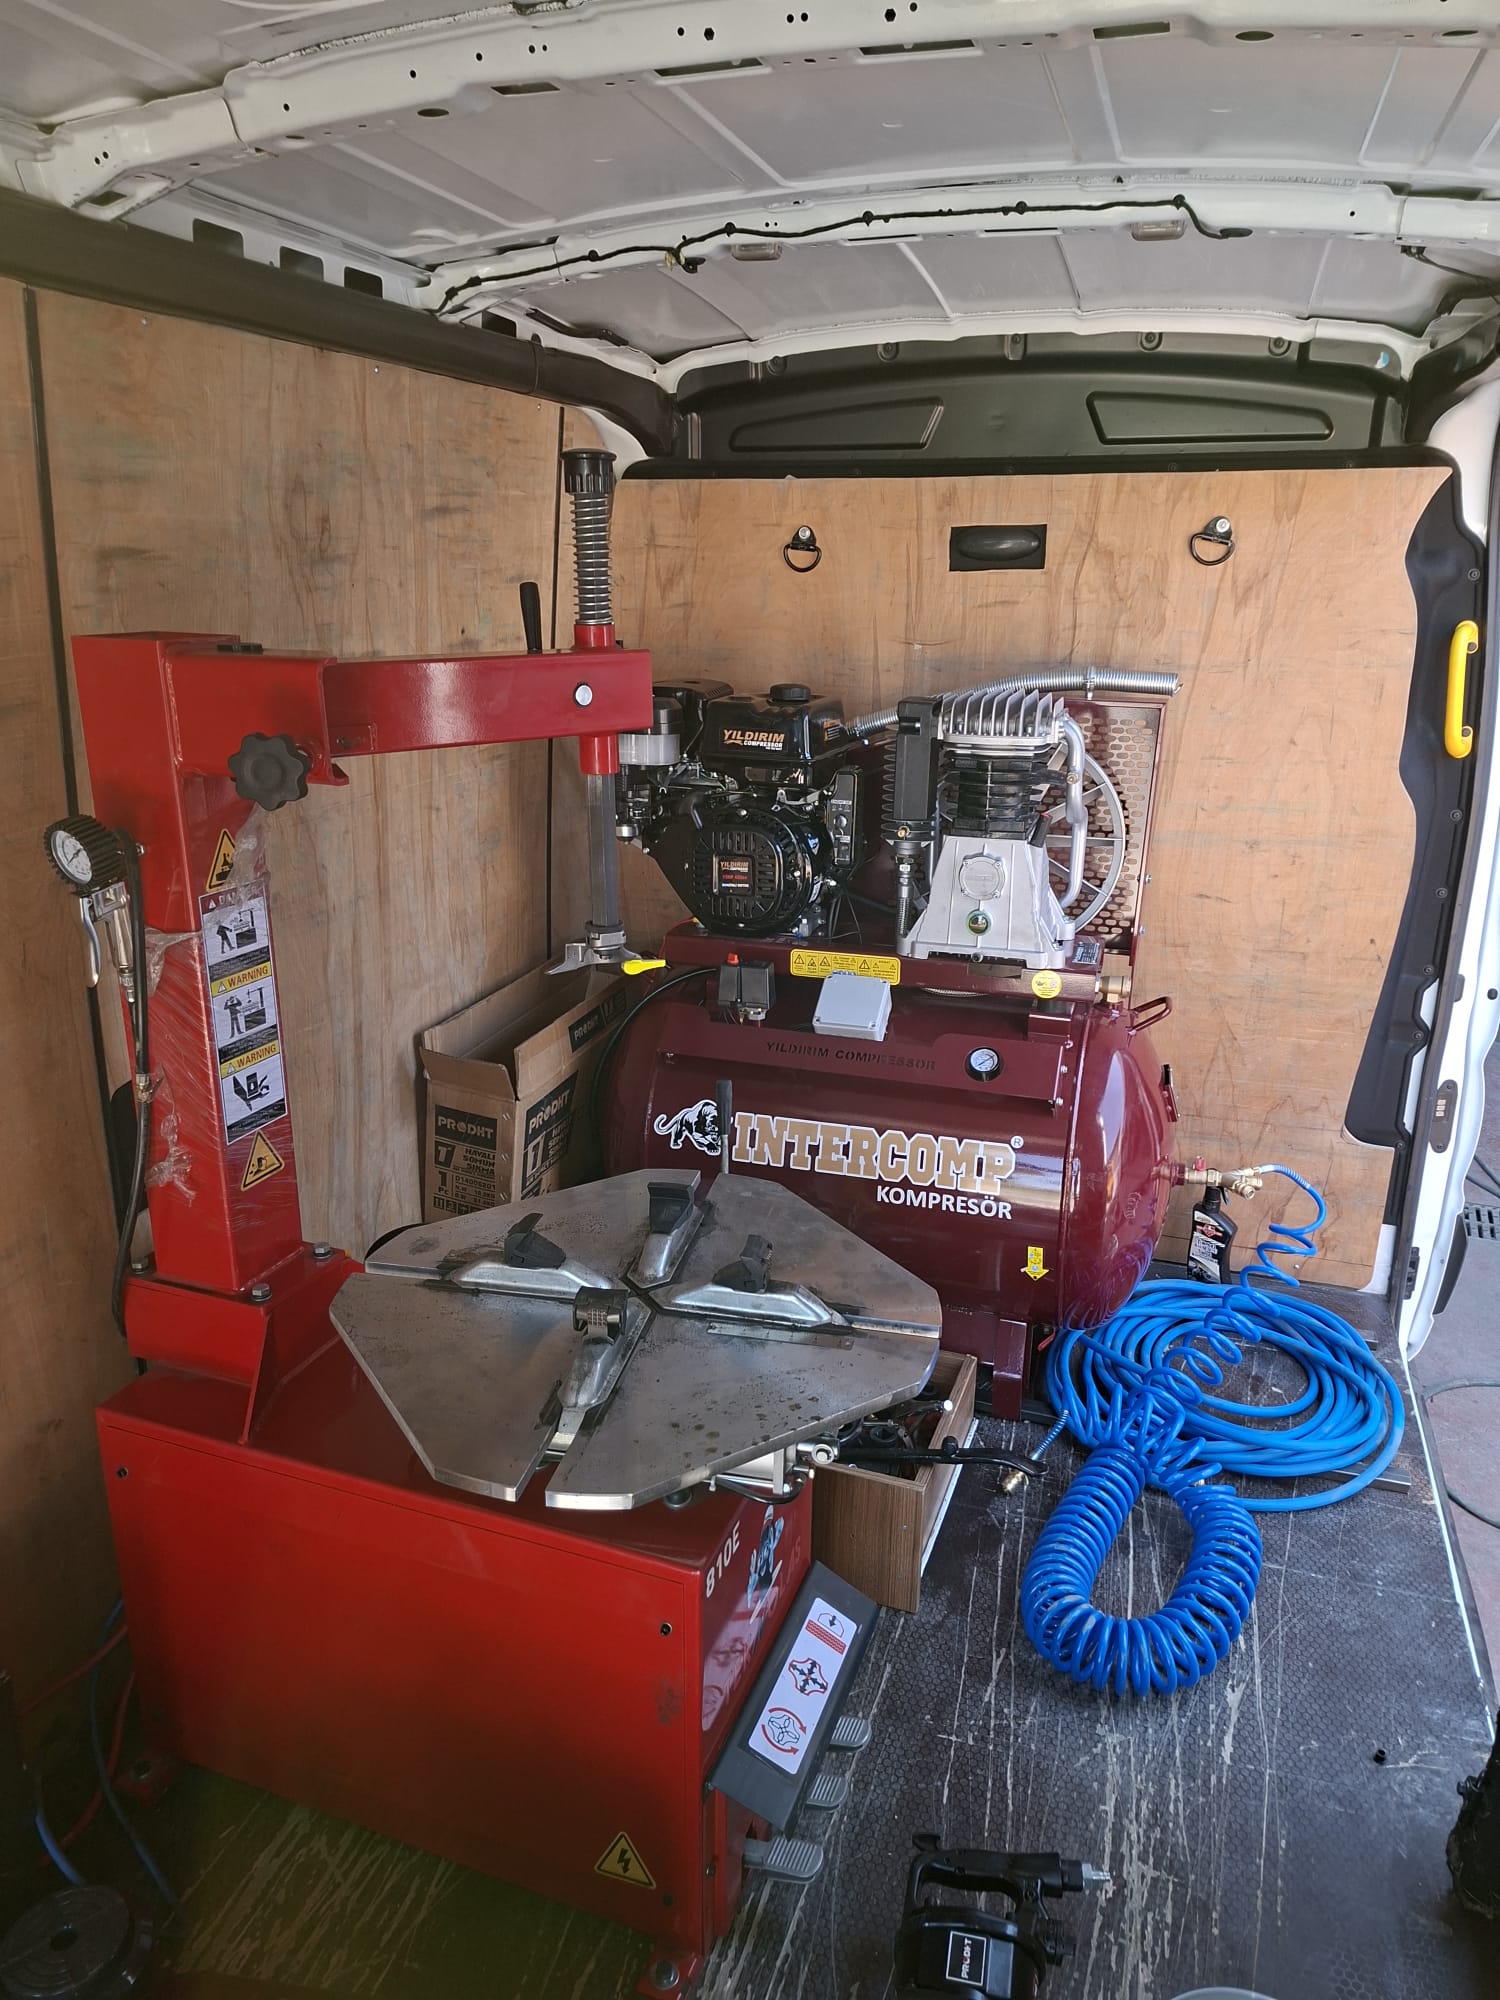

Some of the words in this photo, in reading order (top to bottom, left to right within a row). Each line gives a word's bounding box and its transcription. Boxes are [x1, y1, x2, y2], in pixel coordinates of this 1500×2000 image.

[723, 729, 785, 742] YILDIRIM
[227, 965, 269, 988] WARNING
[236, 1043, 277, 1068] WARNING
[766, 1041, 829, 1058] YILDIRIM
[732, 1111, 1016, 1196] INTERCOMP
[876, 1185, 1013, 1220] KOMPRESÖR
[706, 1520, 740, 1598] 810E
